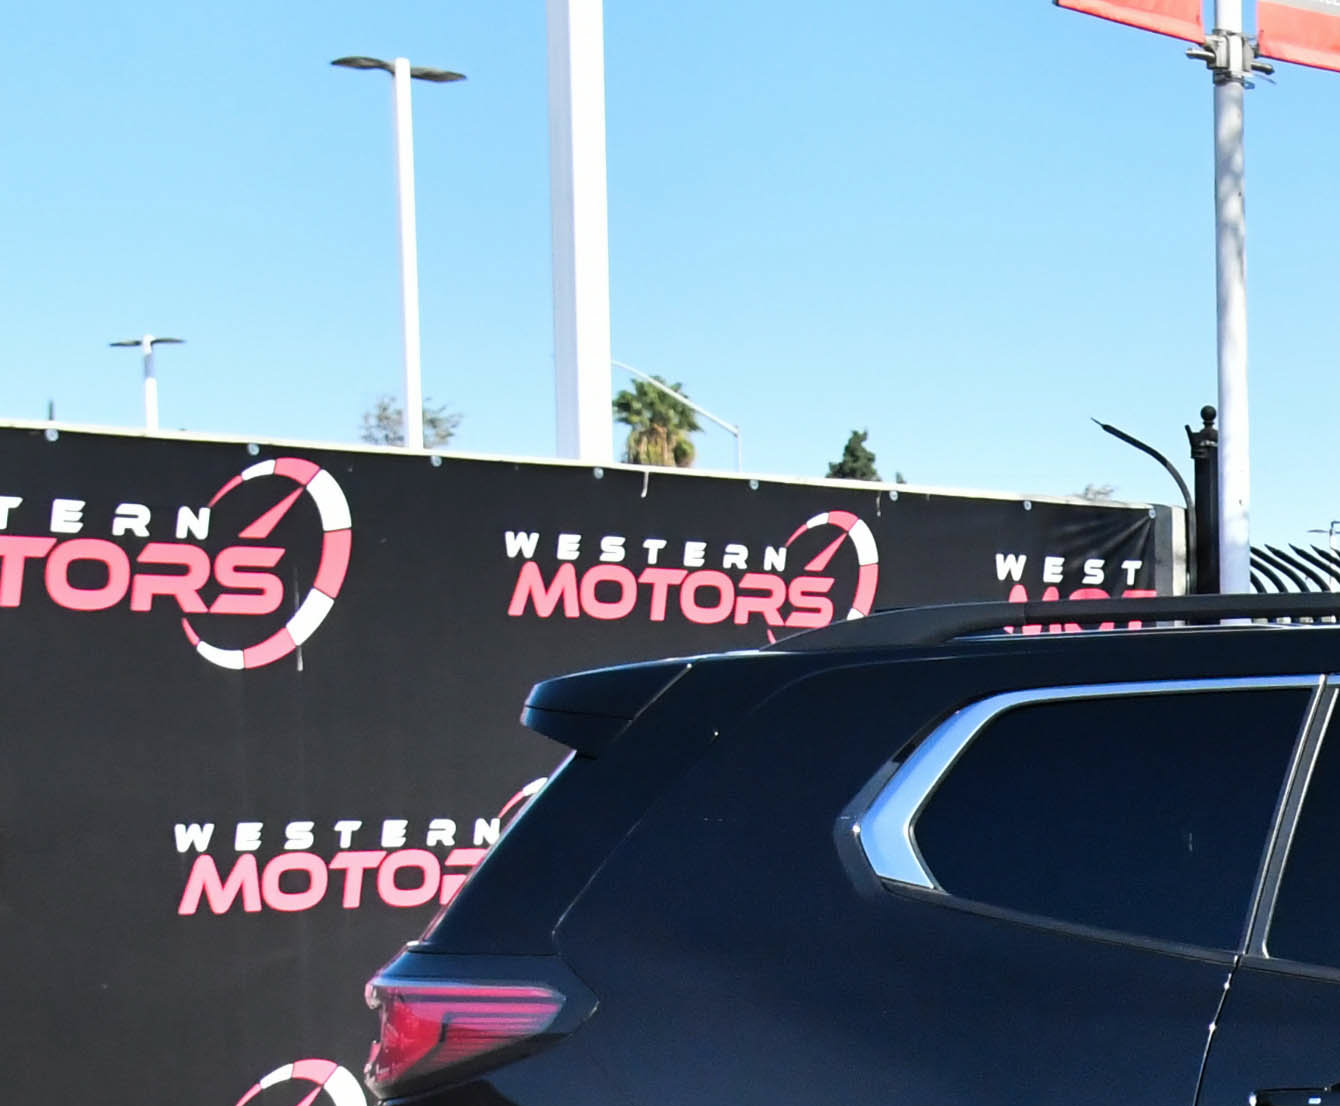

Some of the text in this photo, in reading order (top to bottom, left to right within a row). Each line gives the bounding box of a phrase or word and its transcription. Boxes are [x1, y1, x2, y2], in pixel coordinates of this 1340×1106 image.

[0, 496, 210, 540] TERN
[504, 531, 789, 572] WESTERN
[995, 553, 1143, 586] WEST
[0, 535, 286, 614] TORS
[507, 561, 835, 627] MOTORS
[174, 817, 501, 852] WESTERN
